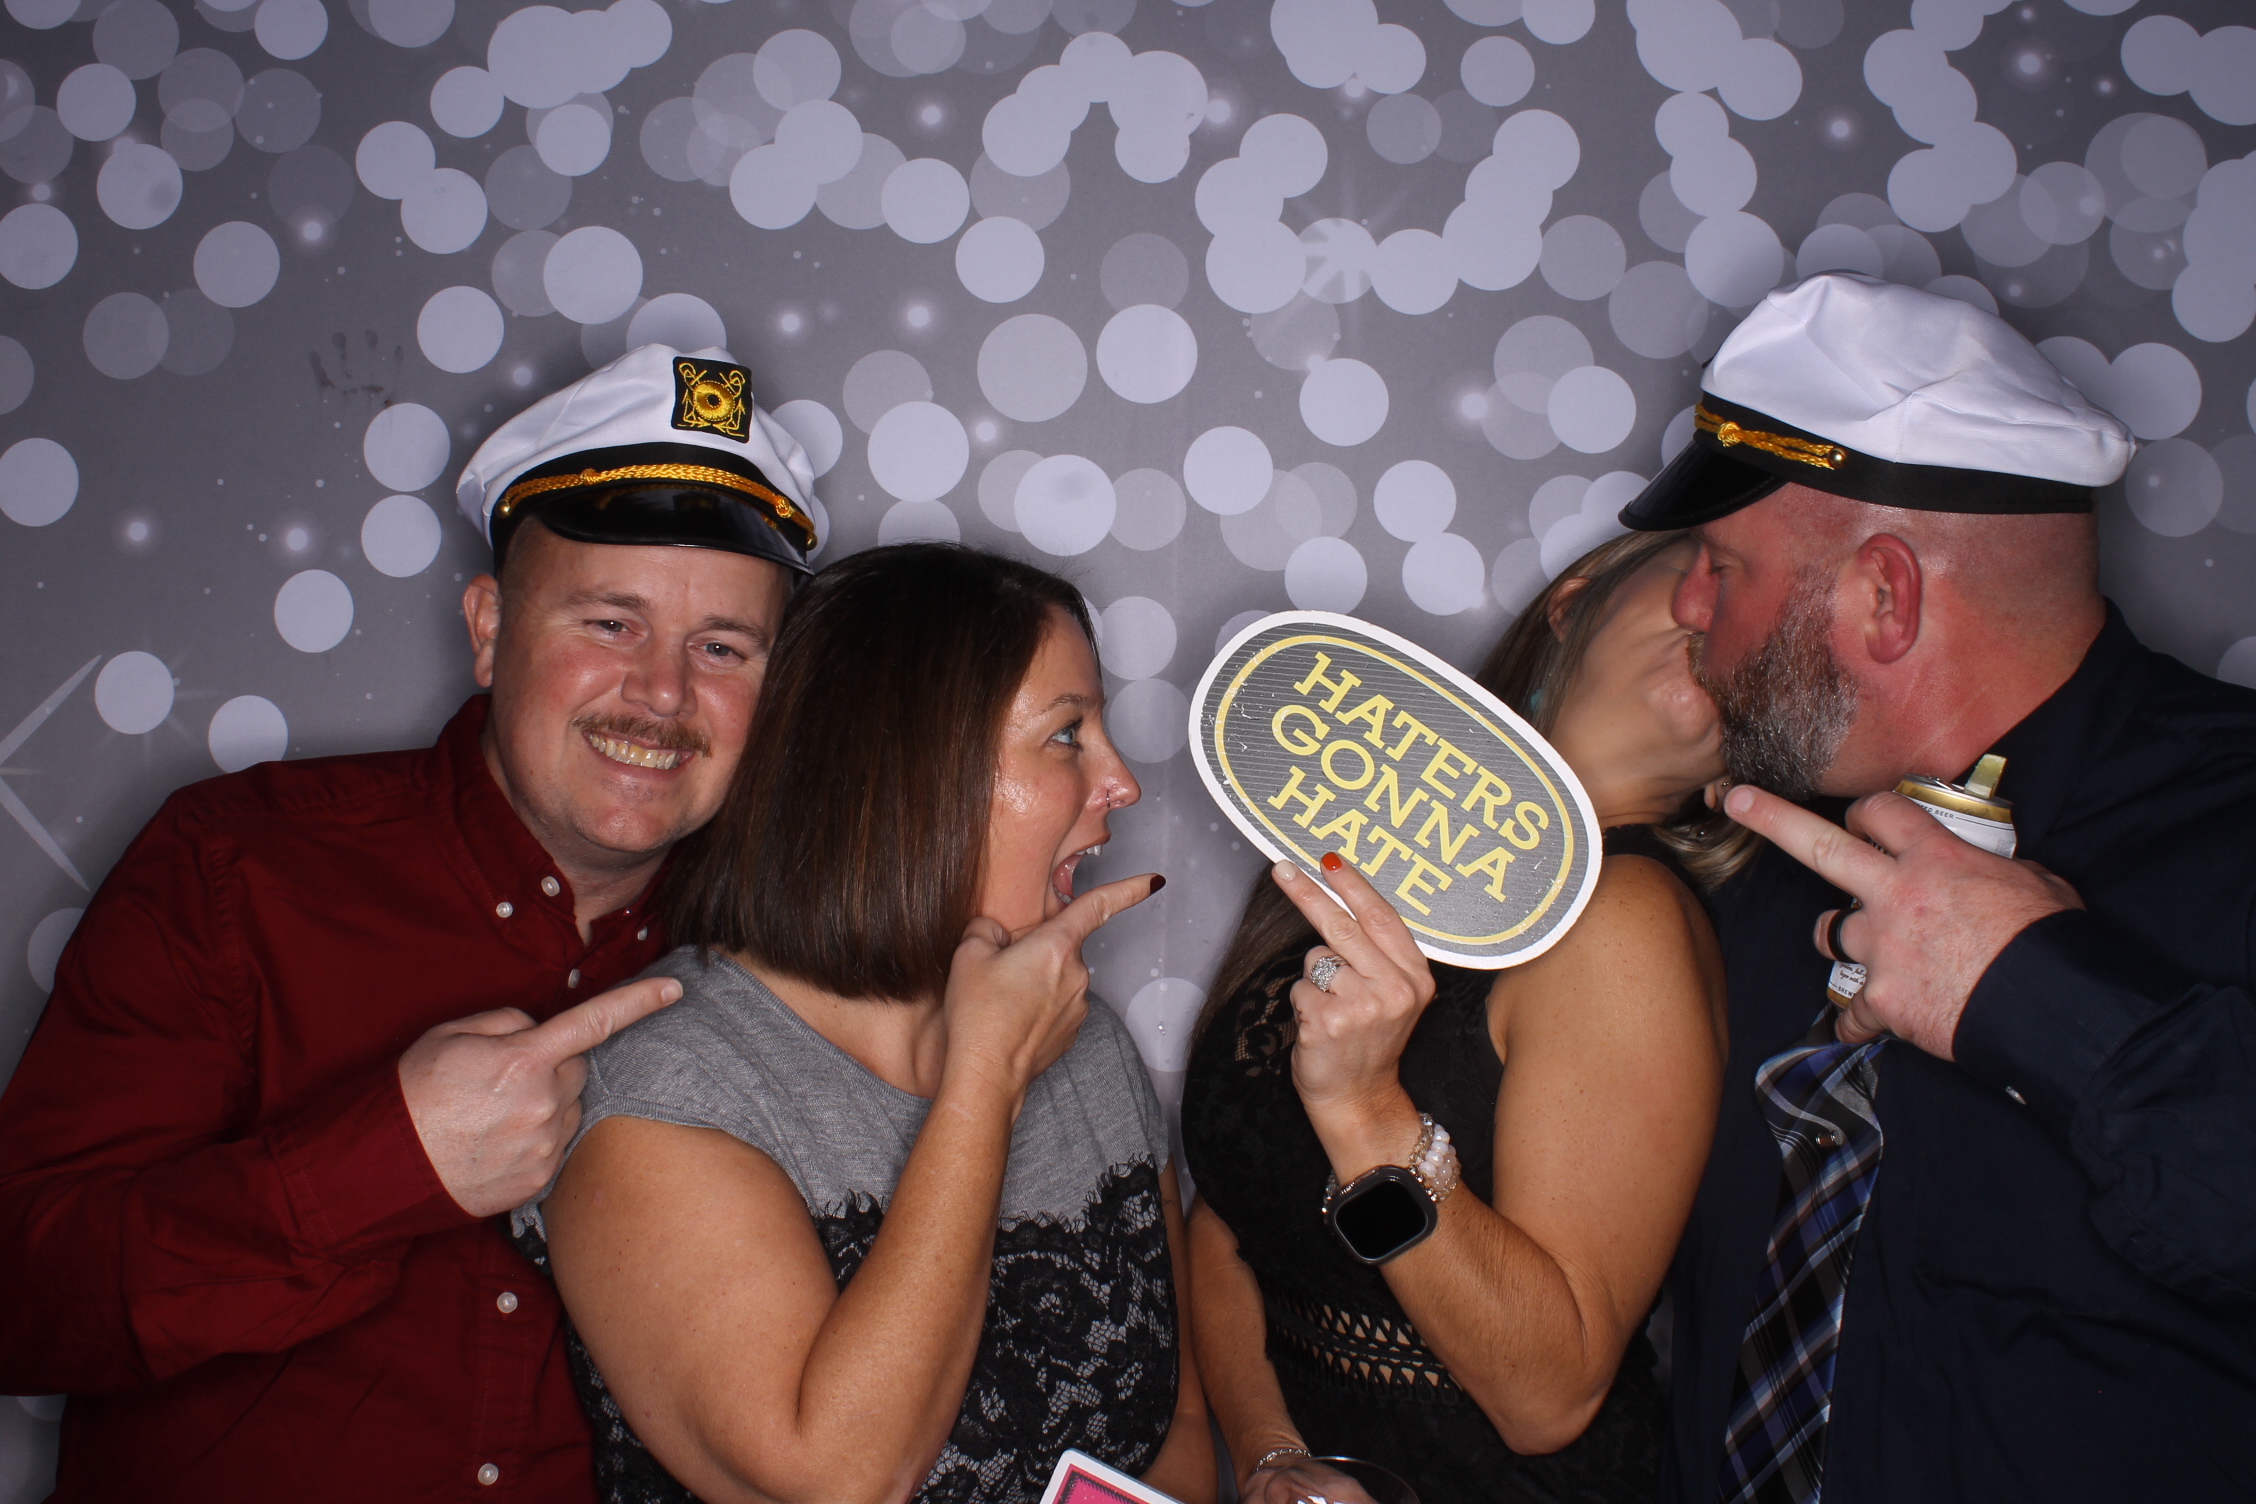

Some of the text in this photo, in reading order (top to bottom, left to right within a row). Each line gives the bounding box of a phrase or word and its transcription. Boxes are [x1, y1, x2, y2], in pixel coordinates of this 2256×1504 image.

[1271, 704, 1516, 903] GONNA
[1293, 652, 1549, 850] HATERS
[1934, 810, 1954, 819] BEER
[1267, 766, 1453, 916] HATE
